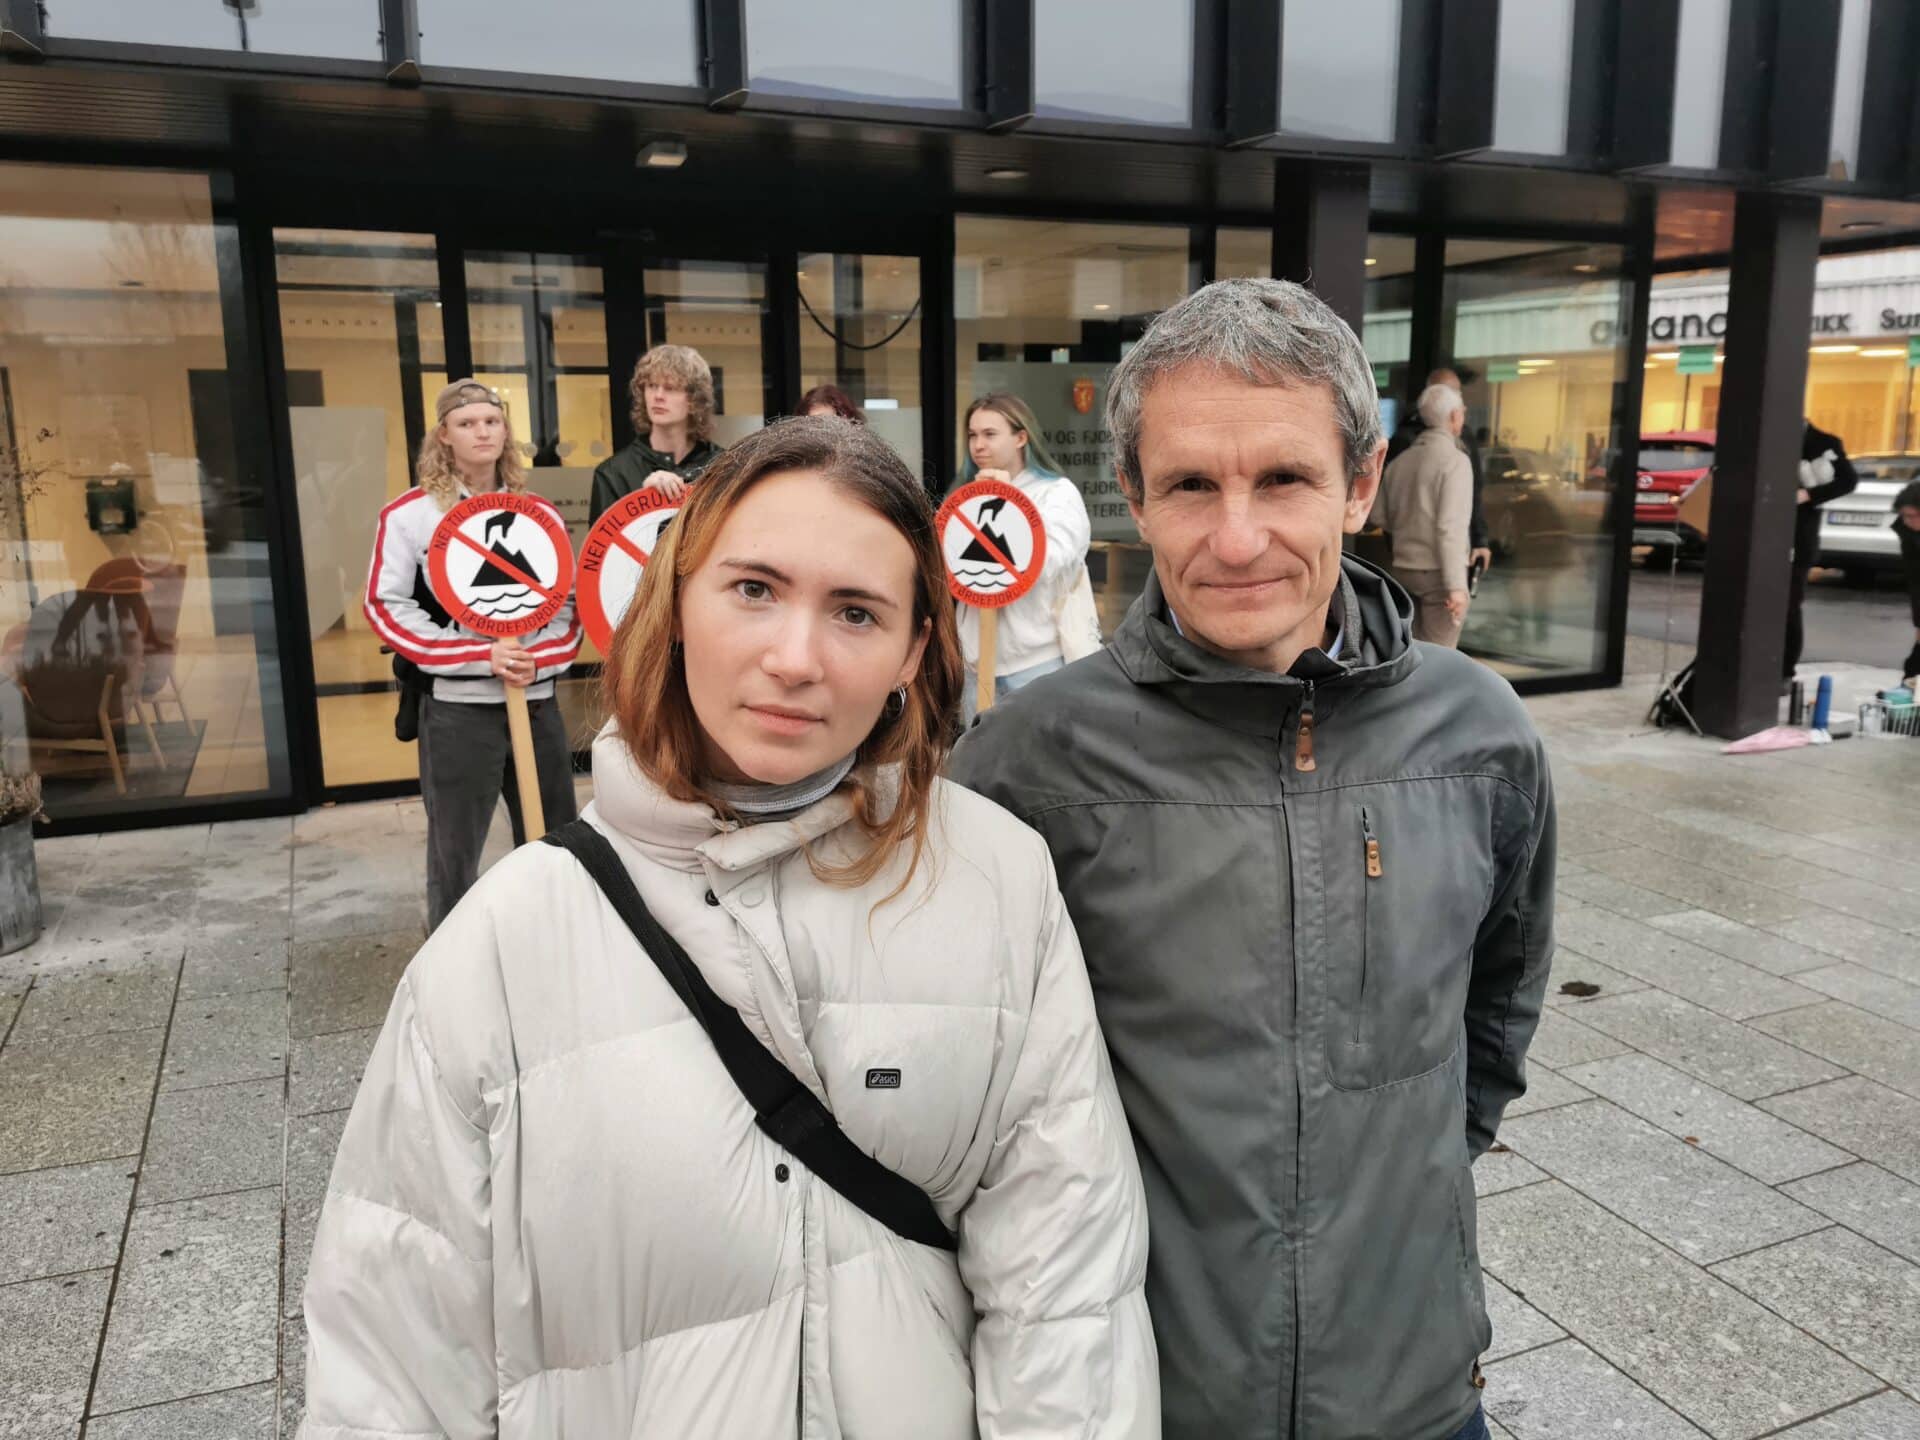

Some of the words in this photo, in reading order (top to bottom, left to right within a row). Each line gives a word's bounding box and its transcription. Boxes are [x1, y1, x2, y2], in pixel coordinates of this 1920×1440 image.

[1055, 430, 1077, 444] OG
[434, 526, 454, 551] NEI
[447, 510, 467, 528] TIL
[466, 496, 555, 531] GRUVEAVFALL
[961, 483, 1040, 528] GRUVEDUMPING
[583, 539, 607, 572] NEI
[598, 515, 625, 537] TIL
[463, 592, 564, 633] FØRDEFJORDEN
